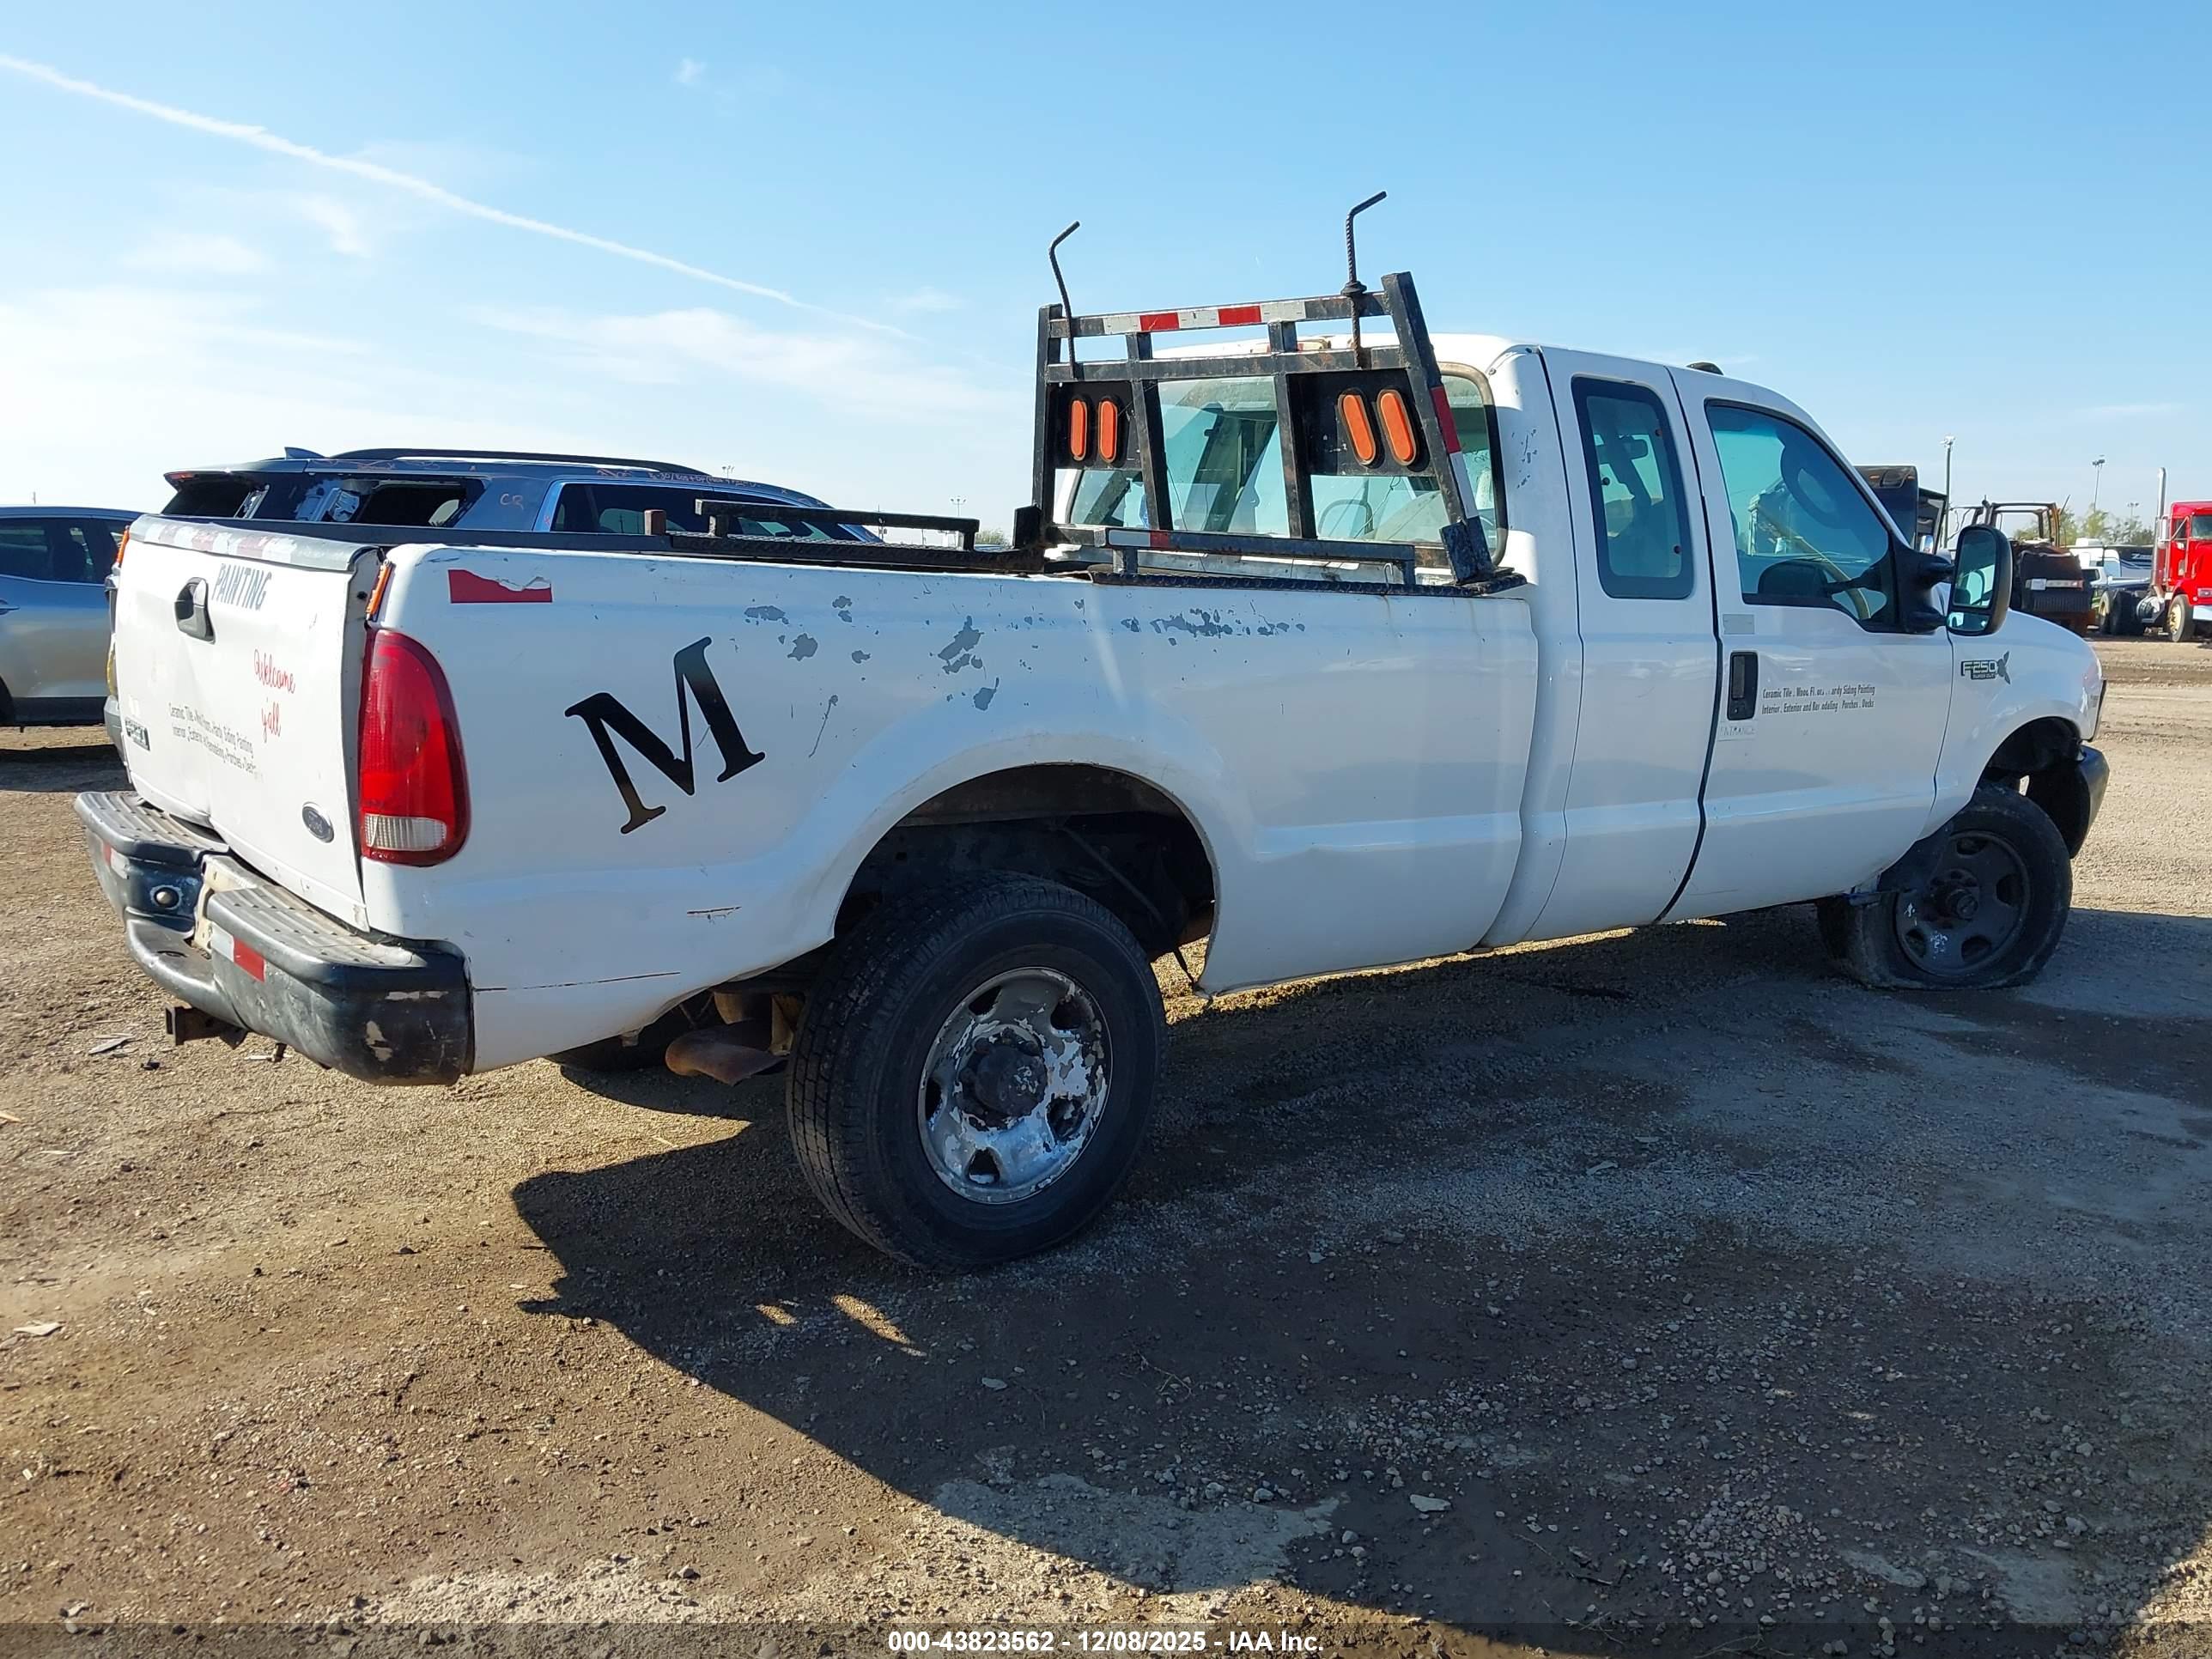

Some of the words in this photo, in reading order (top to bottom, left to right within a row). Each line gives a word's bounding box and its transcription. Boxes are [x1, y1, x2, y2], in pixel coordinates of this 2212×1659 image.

[211, 563, 272, 611] PAINTING
[254, 648, 295, 694] Welcome
[1763, 688, 1782, 699] Ceramic
[1784, 687, 1792, 697] Tile
[1843, 684, 1856, 696] Siding
[1858, 684, 1875, 696] Painting
[1803, 702, 1812, 711] and
[564, 636, 766, 835] M
